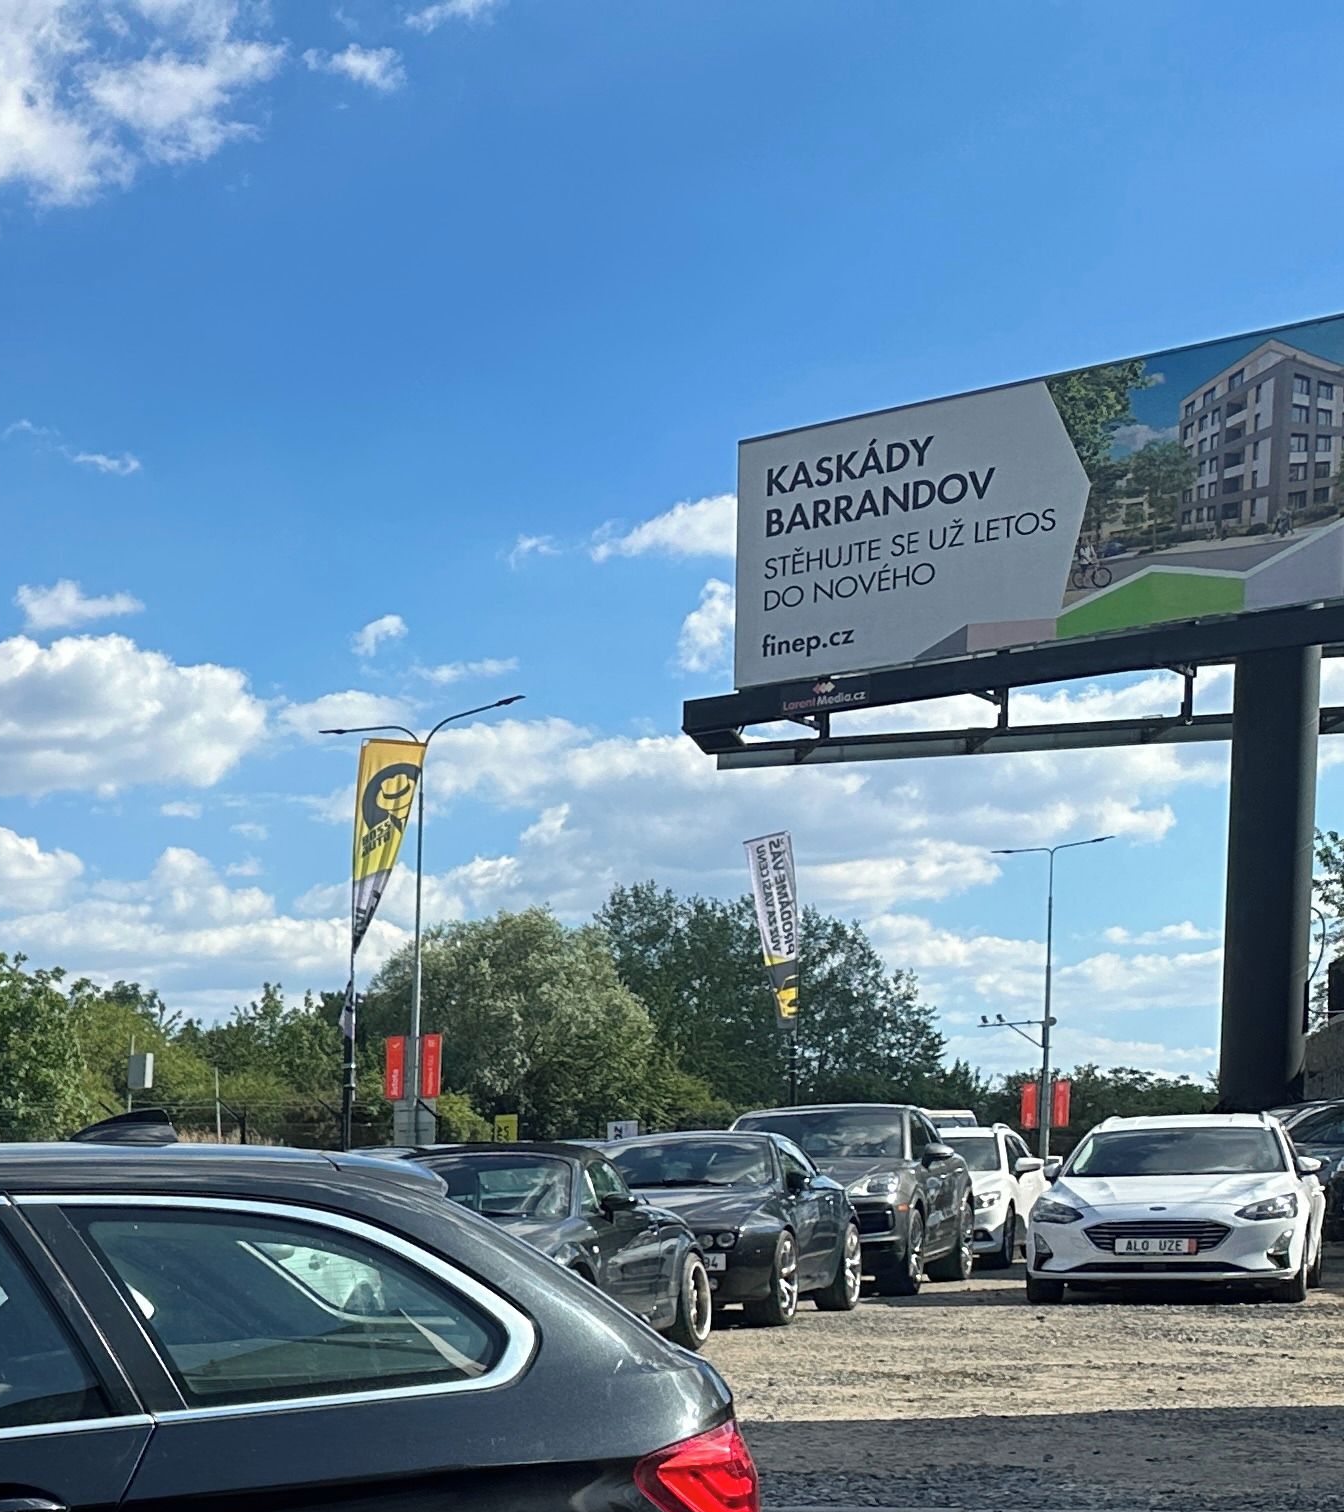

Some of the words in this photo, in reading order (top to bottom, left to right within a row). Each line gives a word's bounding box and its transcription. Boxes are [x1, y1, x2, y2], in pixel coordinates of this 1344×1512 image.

[766, 435, 934, 497] KASKÁDY
[766, 467, 996, 538] BARRANDOV
[764, 539, 882, 580] STĚHUJTE
[891, 532, 920, 557] SE
[928, 518, 964, 551] UŽ
[974, 507, 1057, 544] LETOS
[763, 584, 805, 612] DO
[814, 562, 936, 605] NOVÉHO
[762, 627, 855, 659] finep.cz
